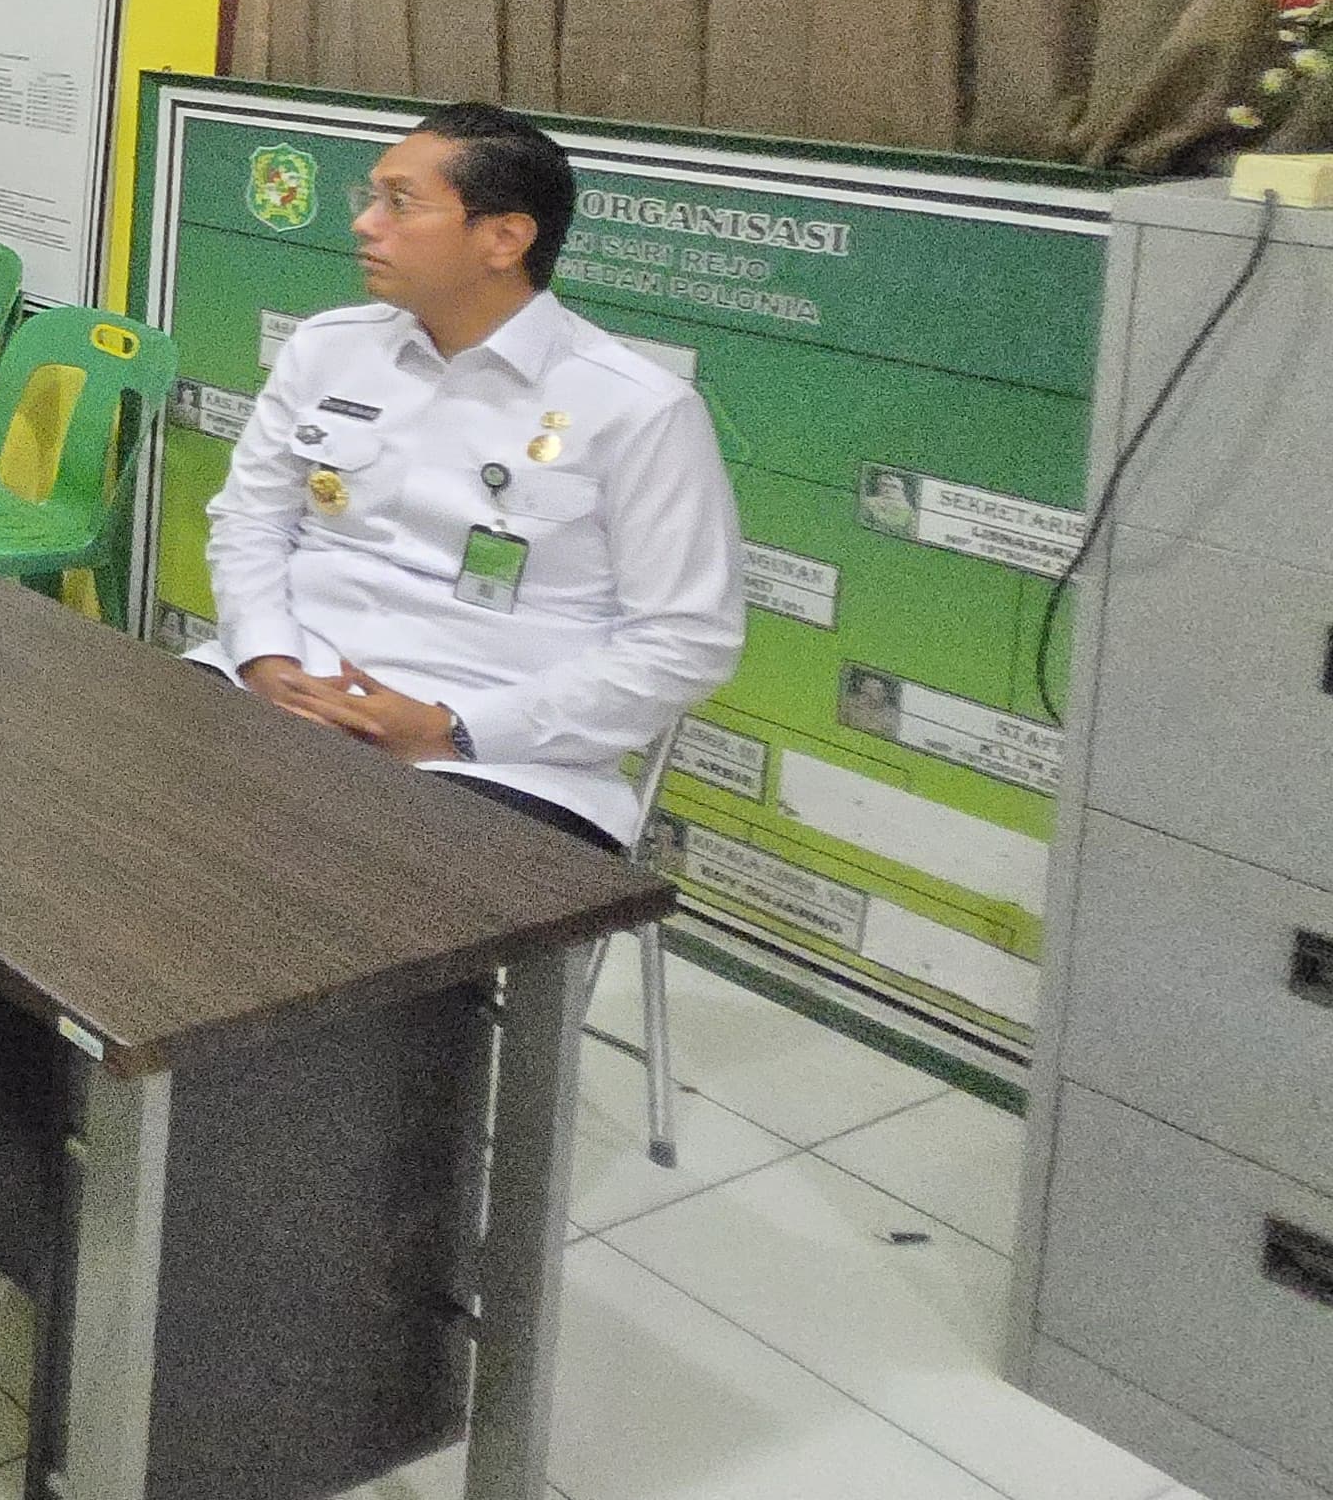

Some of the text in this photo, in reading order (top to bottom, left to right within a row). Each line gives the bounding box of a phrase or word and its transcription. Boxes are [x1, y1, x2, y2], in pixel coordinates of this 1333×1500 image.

[581, 189, 851, 257] ORGANISASI
[600, 233, 675, 266] SARI
[680, 248, 769, 282] REJO
[666, 273, 822, 325] POLONIA
